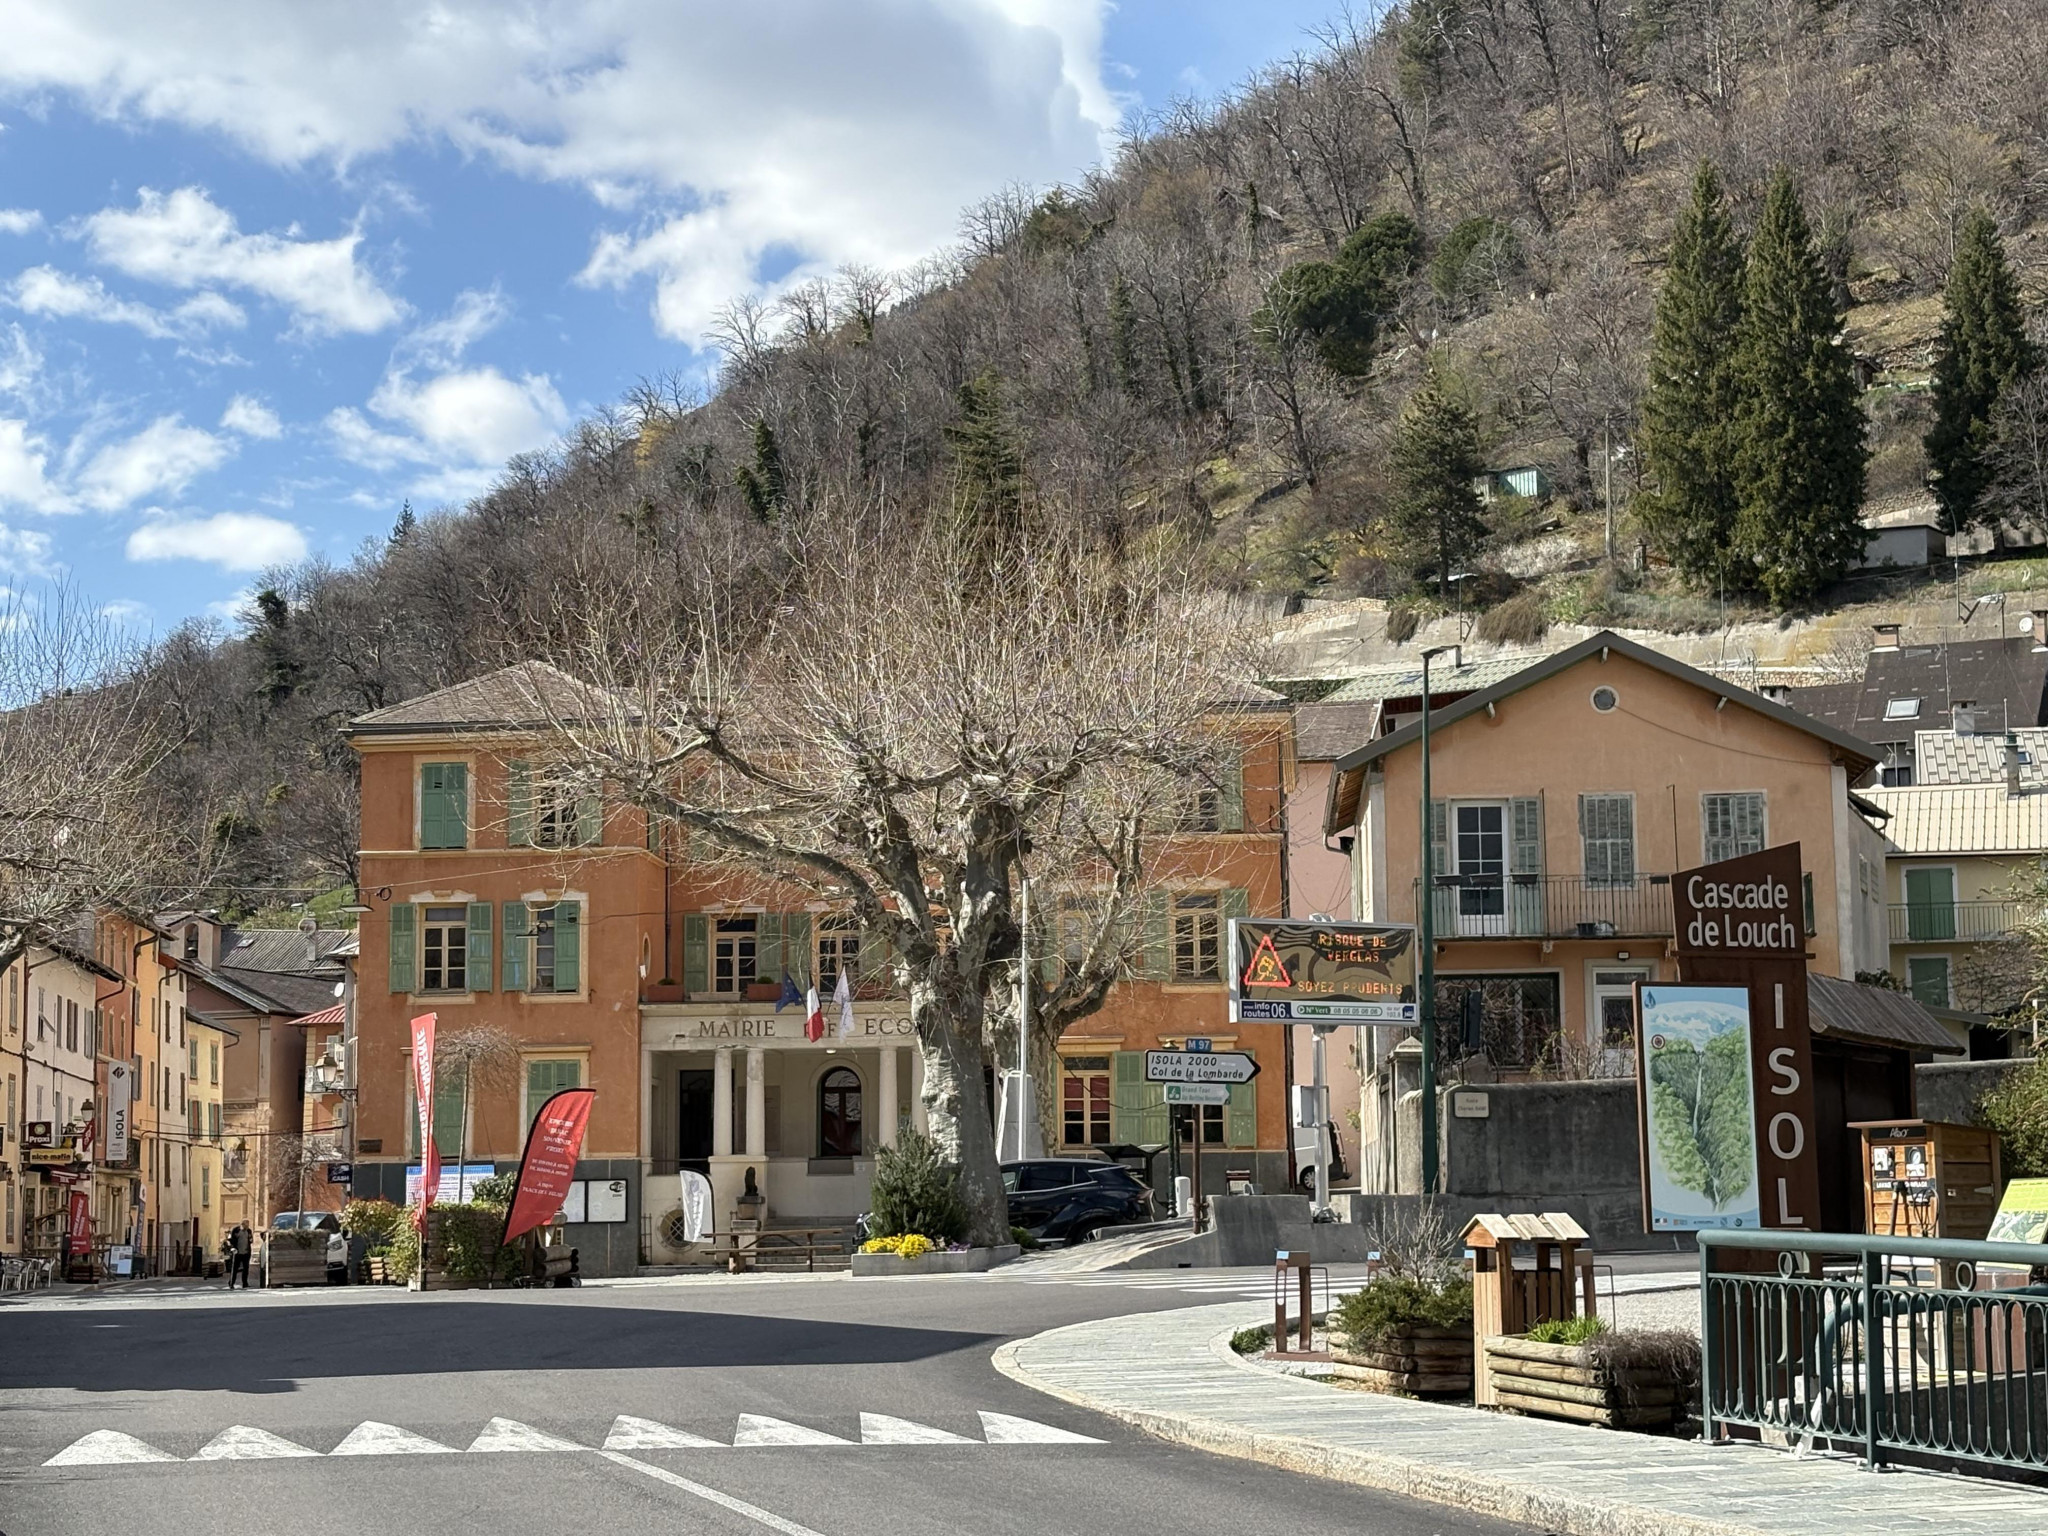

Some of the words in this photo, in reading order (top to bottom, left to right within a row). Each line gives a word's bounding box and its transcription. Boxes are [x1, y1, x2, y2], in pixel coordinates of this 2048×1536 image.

[1687, 874, 1789, 909] Cascade
[1688, 911, 1719, 946] de
[1724, 913, 1796, 948] Louch
[1318, 934, 1364, 947] RISQUE
[1372, 935, 1386, 948] DE
[1327, 951, 1380, 963] VERGLAS
[1297, 981, 1335, 993] SOYEZ
[1243, 1010, 1270, 1018] routes
[1271, 1003, 1286, 1018] 06
[698, 1020, 776, 1037] MAIRIE
[864, 1018, 914, 1035] ECO
[1187, 1040, 1196, 1049] M
[1198, 1040, 1210, 1049] 97
[1151, 1055, 1182, 1066] ISOLA
[1188, 1056, 1217, 1066] 2000
[1151, 1067, 1167, 1077] Col
[1171, 1068, 1182, 1077] de
[1185, 1068, 1194, 1078] la
[1198, 1069, 1244, 1079] Lombarde
[115, 1109, 125, 1139] ISOLA
[29, 1135, 50, 1143] Proxi
